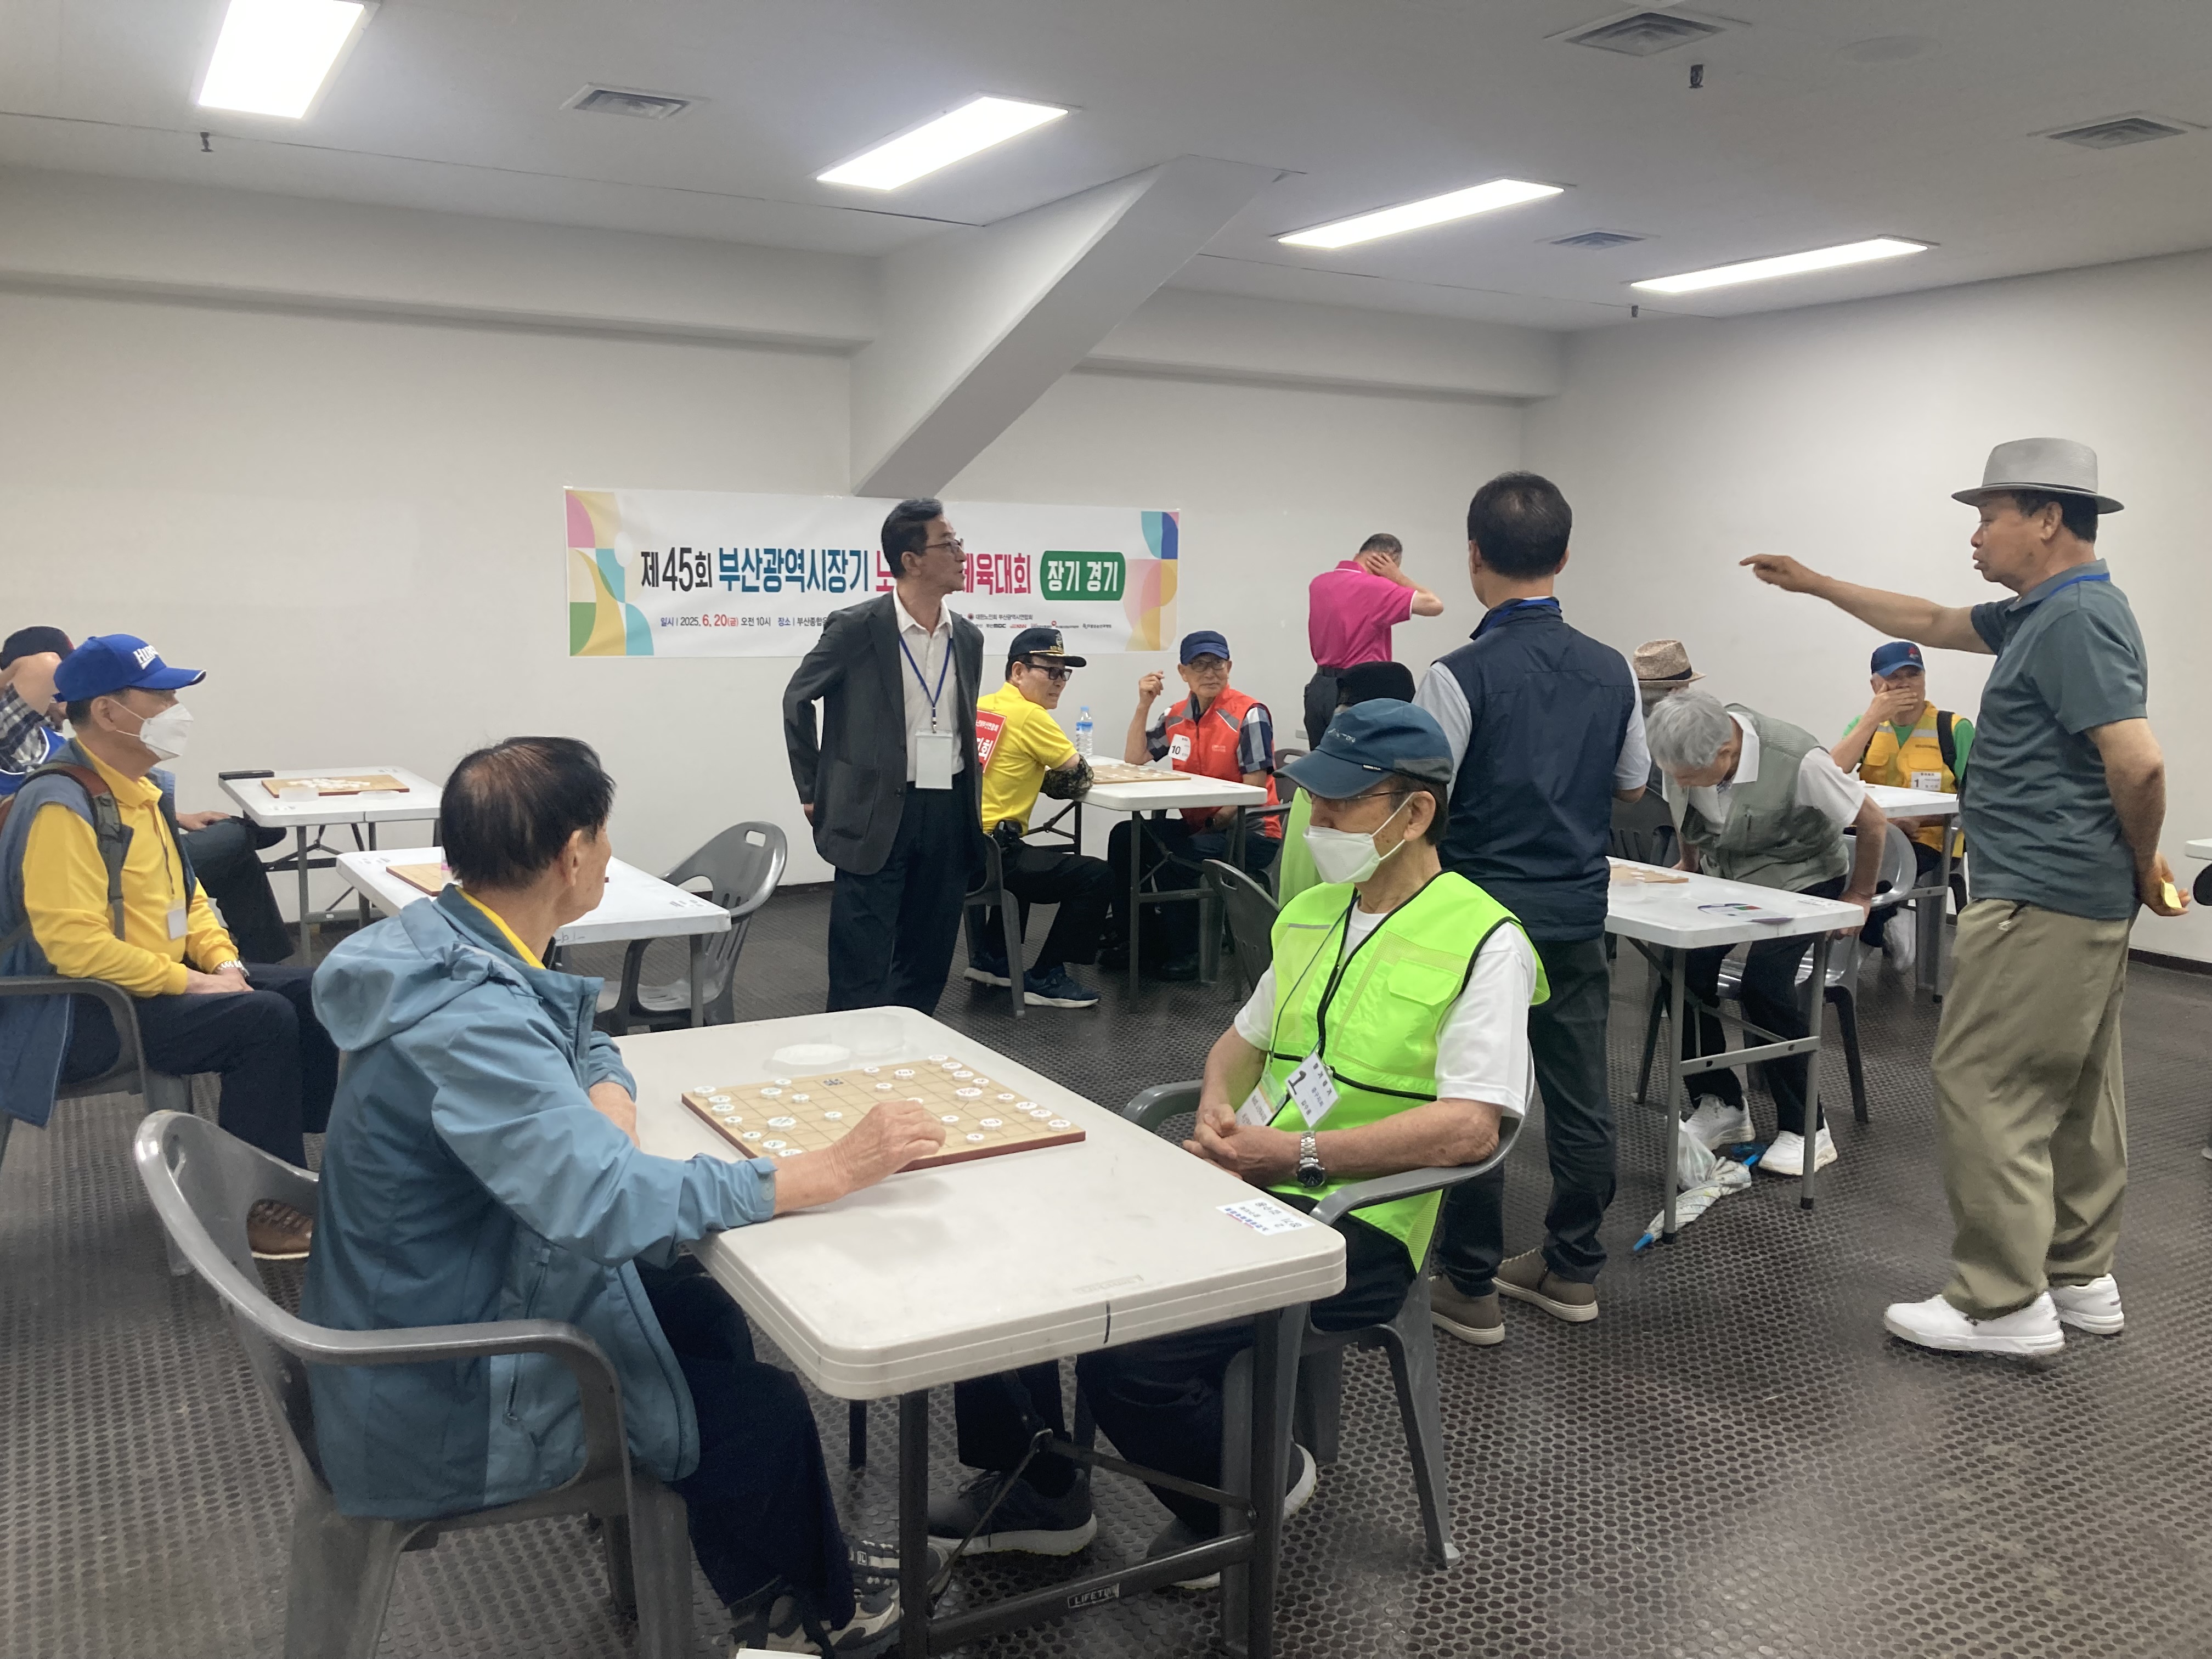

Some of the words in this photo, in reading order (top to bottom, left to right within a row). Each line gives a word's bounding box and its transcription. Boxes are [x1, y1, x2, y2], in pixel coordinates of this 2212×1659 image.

[641, 547, 713, 591] 제45회
[719, 547, 868, 593] 부산광역시장기
[1047, 560, 1080, 591] 장기
[1087, 561, 1118, 592] 경기
[661, 617, 674, 627] 일시
[680, 617, 701, 627] 2025.
[702, 614, 712, 627] 6.
[714, 614, 739, 627] 20(금)
[741, 617, 754, 627] 오전
[757, 617, 771, 627] 10시
[778, 617, 791, 627] 장소
[1172, 745, 1181, 755] 10
[1914, 778, 1919, 788] 1
[1288, 1070, 1307, 1095] 1
